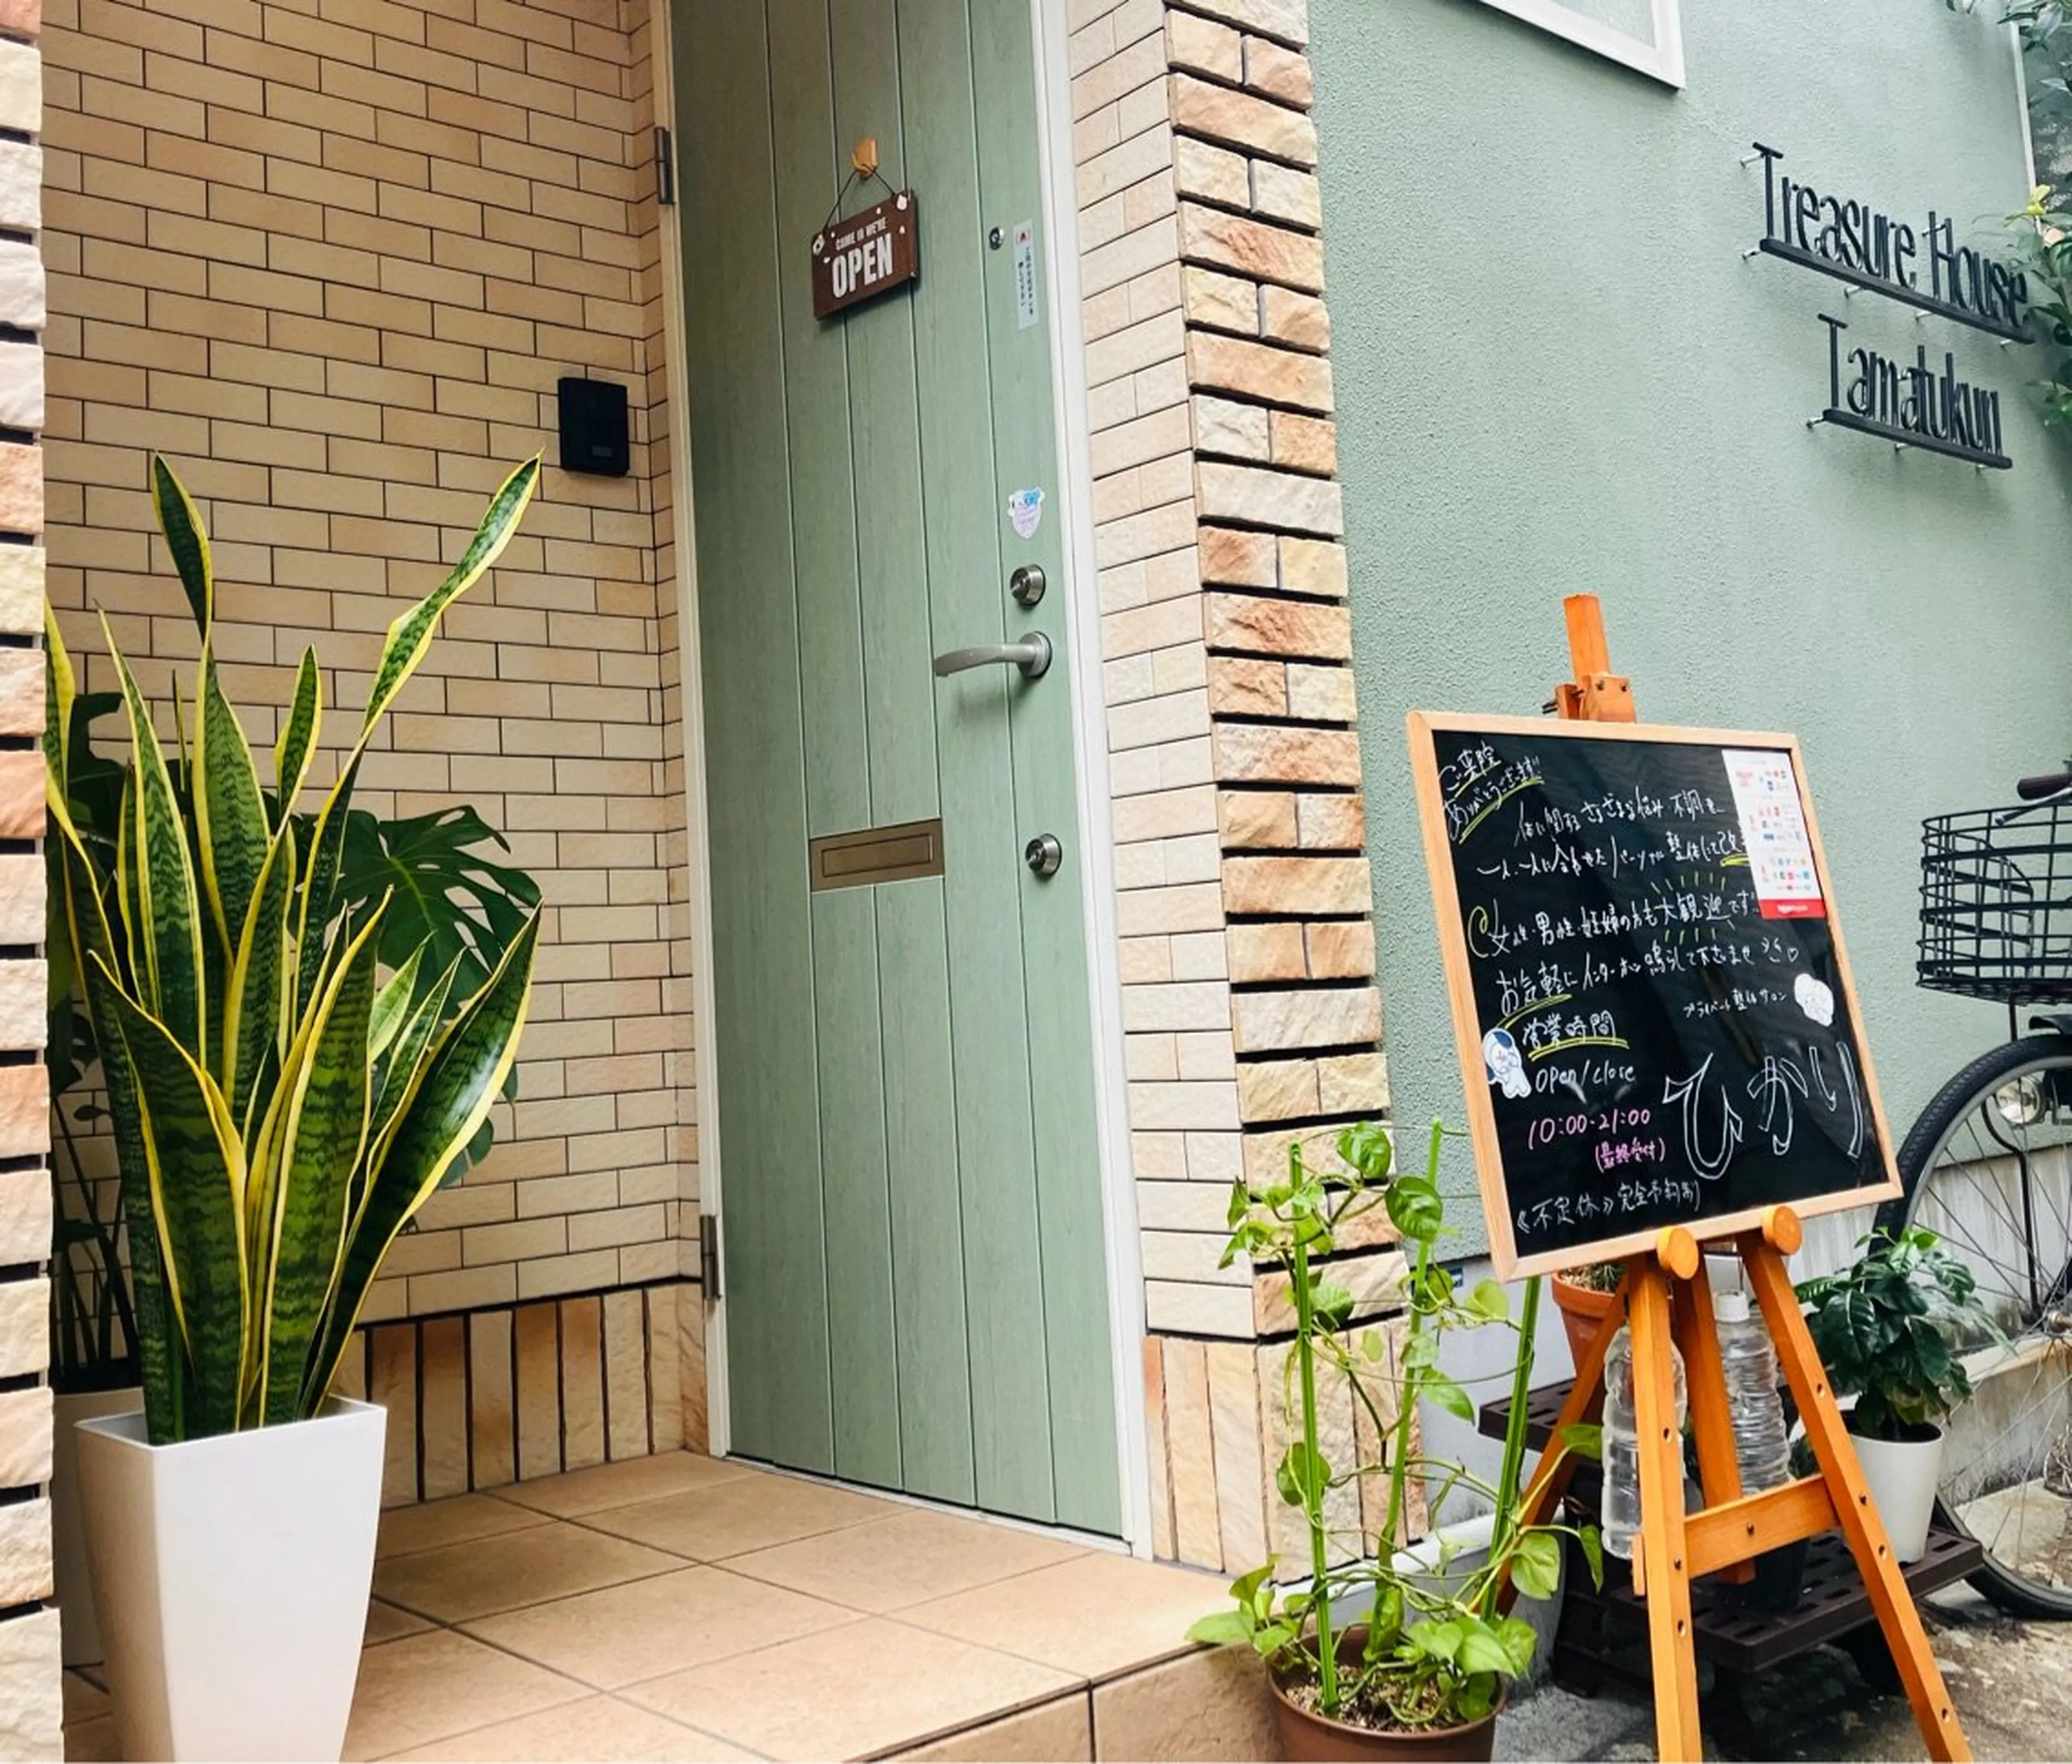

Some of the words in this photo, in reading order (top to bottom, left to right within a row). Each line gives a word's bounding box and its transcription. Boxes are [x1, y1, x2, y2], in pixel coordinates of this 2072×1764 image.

[832, 233, 892, 298] OPEN
[1753, 142, 1917, 290] Treasure
[1928, 211, 2028, 328] House
[1818, 313, 2003, 457] Tamatukun
[1523, 1010, 1617, 1050] 営業時間
[1662, 1041, 1863, 1180] ひかり
